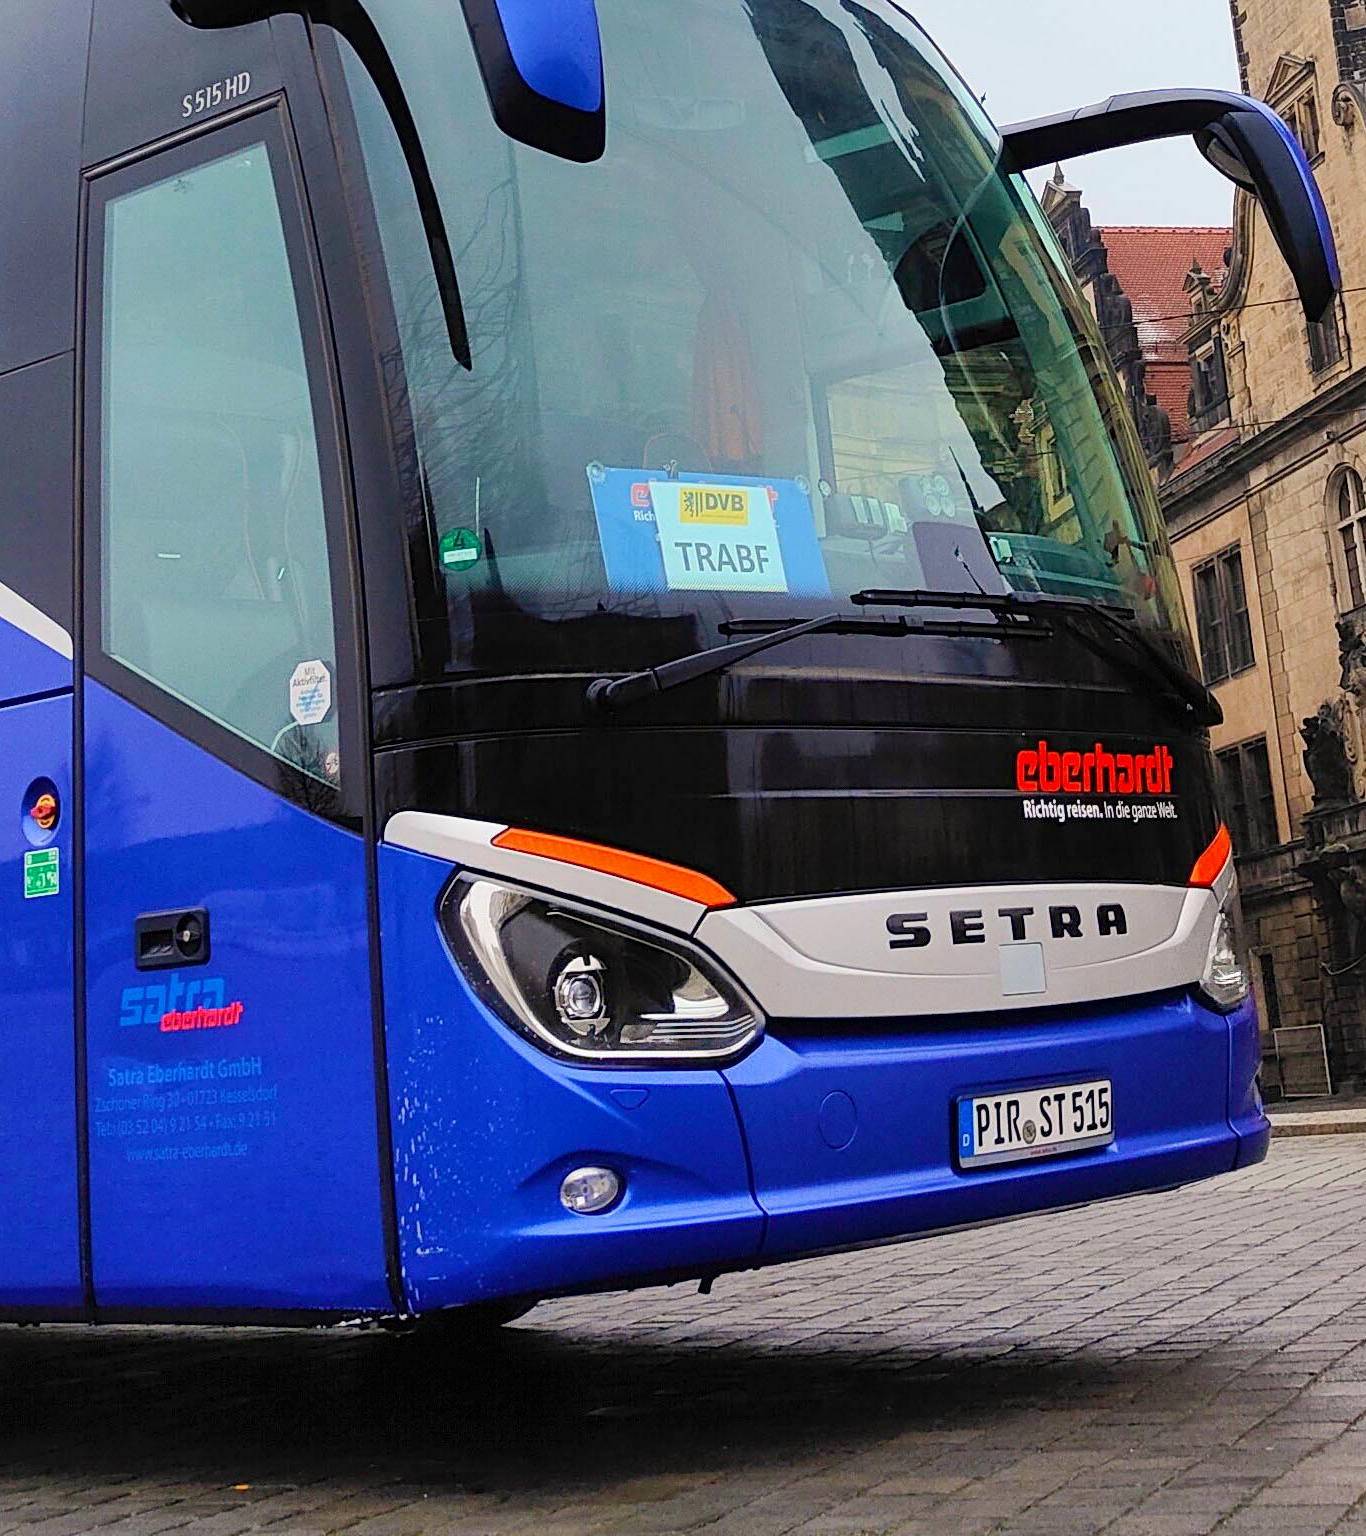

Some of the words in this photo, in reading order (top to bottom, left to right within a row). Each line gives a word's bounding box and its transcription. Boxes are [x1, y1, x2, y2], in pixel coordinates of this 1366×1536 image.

[182, 94, 193, 118] S
[195, 81, 222, 113] 515
[225, 71, 251, 100] HD
[705, 493, 745, 512] DVB
[674, 542, 770, 574] TRABF
[1016, 740, 1174, 793] eberhardt
[1023, 799, 1066, 823] Richtig
[1066, 799, 1104, 819] reisen.
[1104, 800, 1115, 819] In
[1115, 800, 1131, 819] die
[1131, 805, 1158, 823] ganze
[1156, 801, 1178, 819] Welt.
[885, 902, 1129, 950] SETRA
[119, 972, 225, 1027] satra
[160, 1001, 244, 1032] eberhardt
[108, 1067, 144, 1087] Satra
[147, 1059, 214, 1083] Eberhardt
[217, 1055, 263, 1078] GmbH
[143, 1093, 165, 1113] Ring
[219, 1082, 278, 1104] Kesselsdorf
[976, 1099, 1022, 1147] PIR
[1039, 1093, 1066, 1138] ST
[1071, 1087, 1110, 1133] 515
[962, 1133, 970, 1147] D
